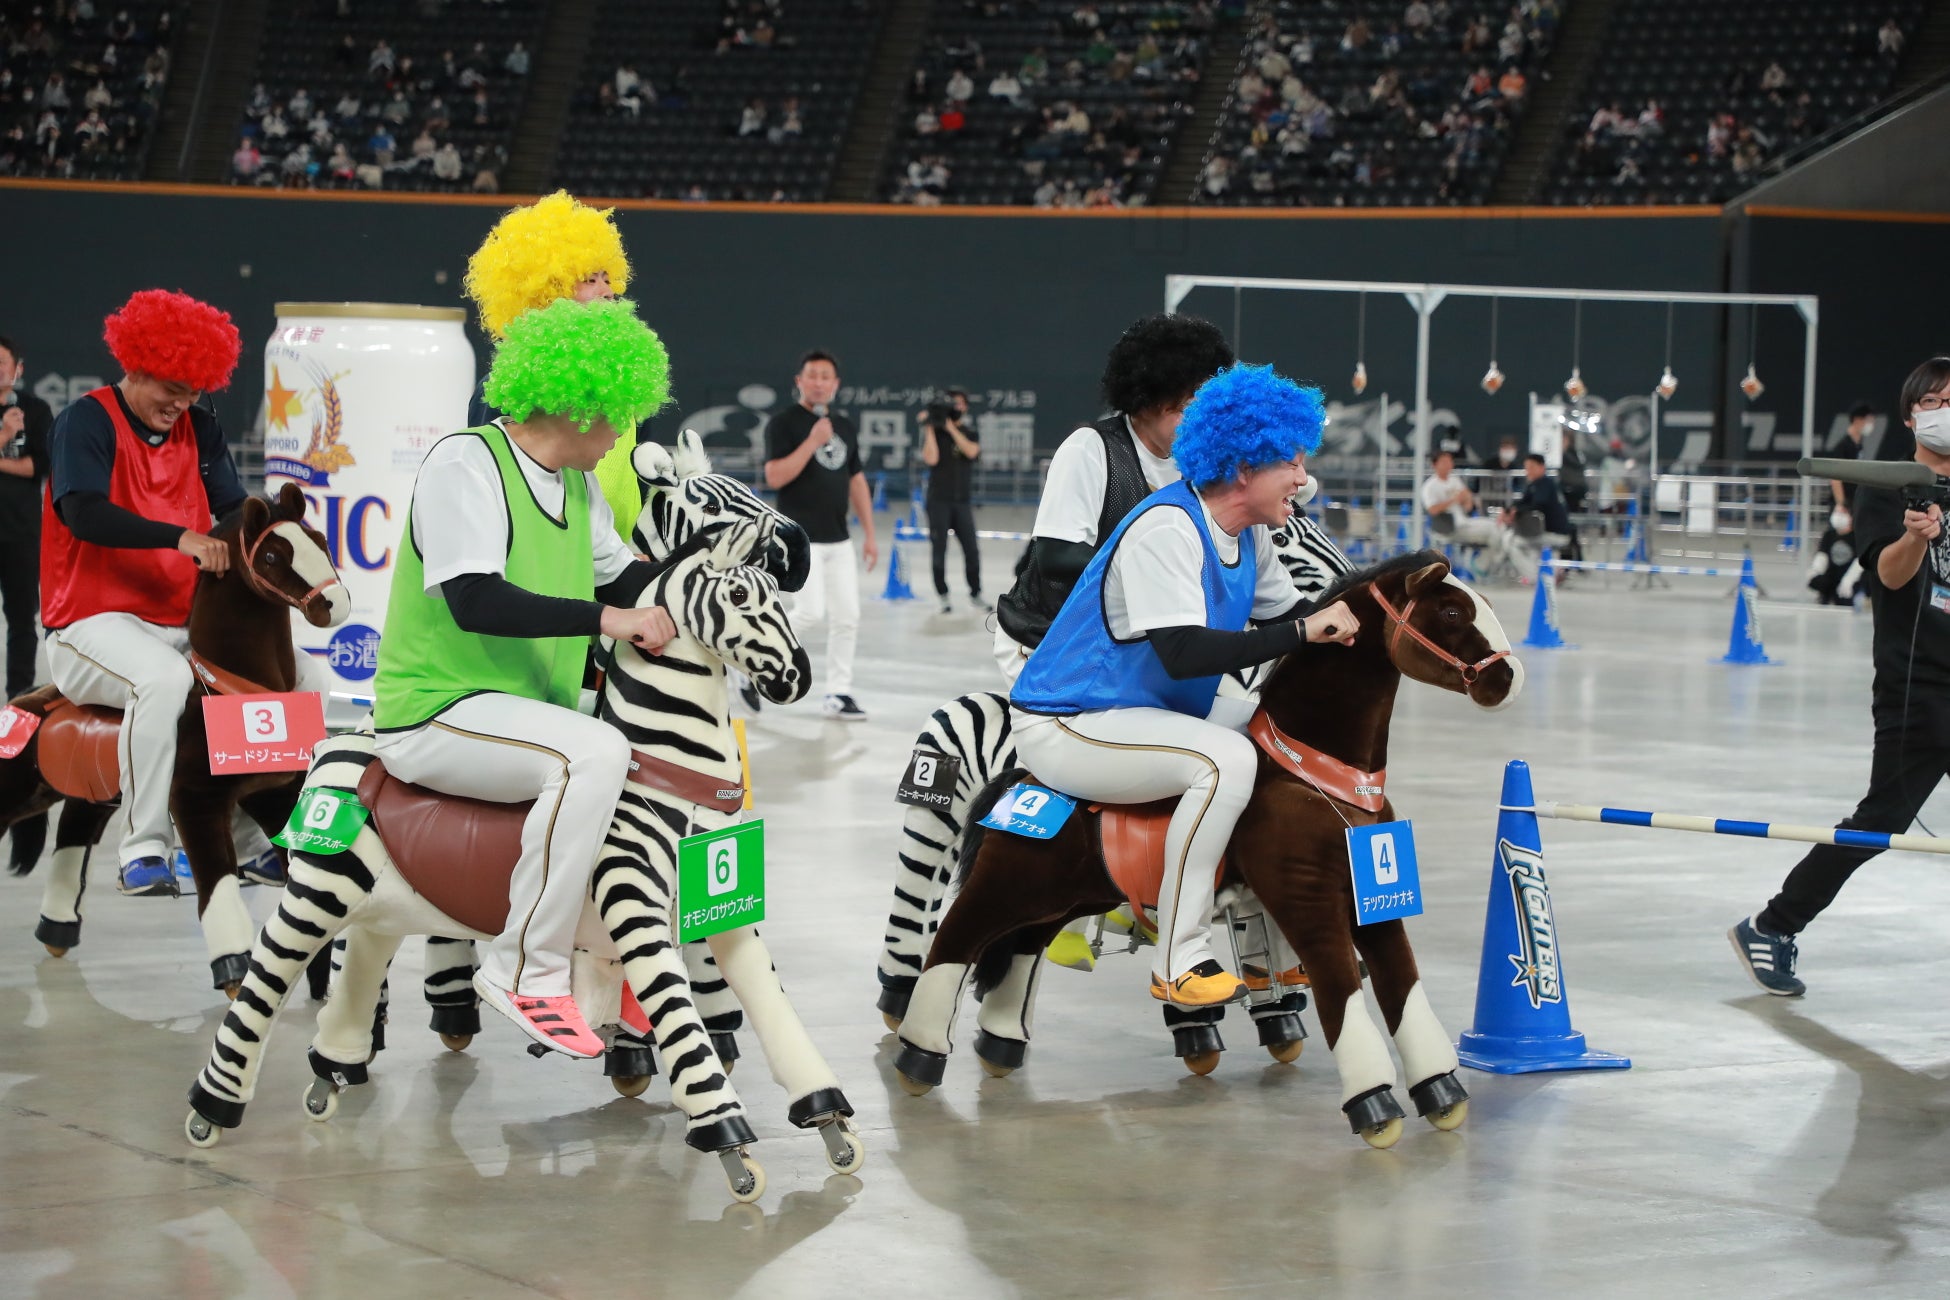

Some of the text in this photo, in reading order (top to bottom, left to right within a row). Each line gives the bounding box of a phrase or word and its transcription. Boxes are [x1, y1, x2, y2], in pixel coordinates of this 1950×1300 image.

[254, 708, 276, 736] 3
[213, 747, 313, 766] サードジェーム
[918, 761, 931, 782] 2
[898, 788, 951, 805] ニューホールドオウ
[1021, 795, 1039, 811] 4
[312, 800, 331, 823] 6
[714, 848, 731, 886] 6
[1379, 842, 1392, 875] 4
[682, 893, 763, 930] オモシロサウスポー
[1362, 889, 1416, 914] テツワンナオキ
